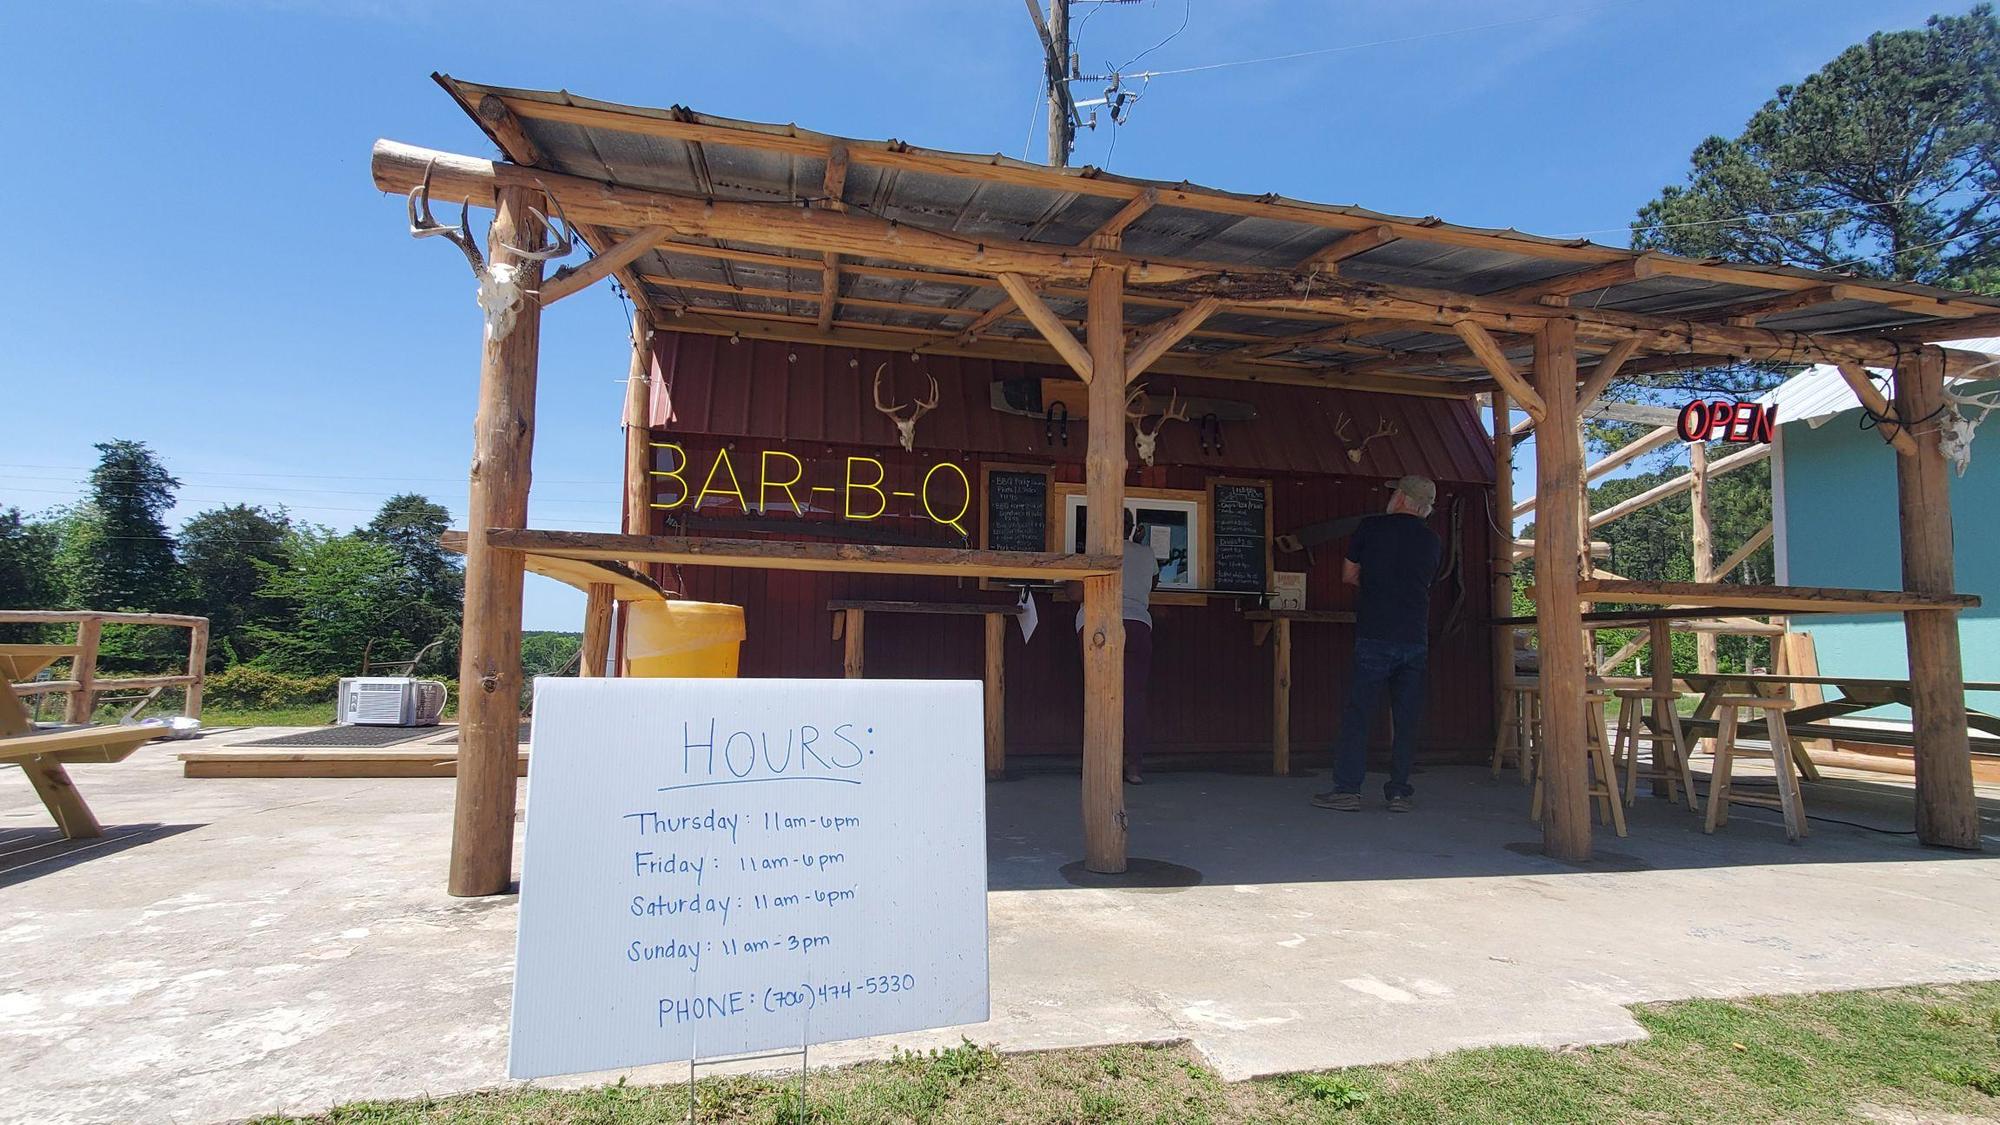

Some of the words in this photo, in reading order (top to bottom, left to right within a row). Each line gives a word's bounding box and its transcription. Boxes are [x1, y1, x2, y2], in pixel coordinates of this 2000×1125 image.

[1677, 399, 1779, 443] OPEN
[649, 442, 969, 536] BAR-B-Q
[683, 717, 874, 778] HOURS:
[631, 893, 742, 927] Saturday:
[628, 939, 711, 973] Sunday:
[660, 992, 755, 1029] PHONE:
